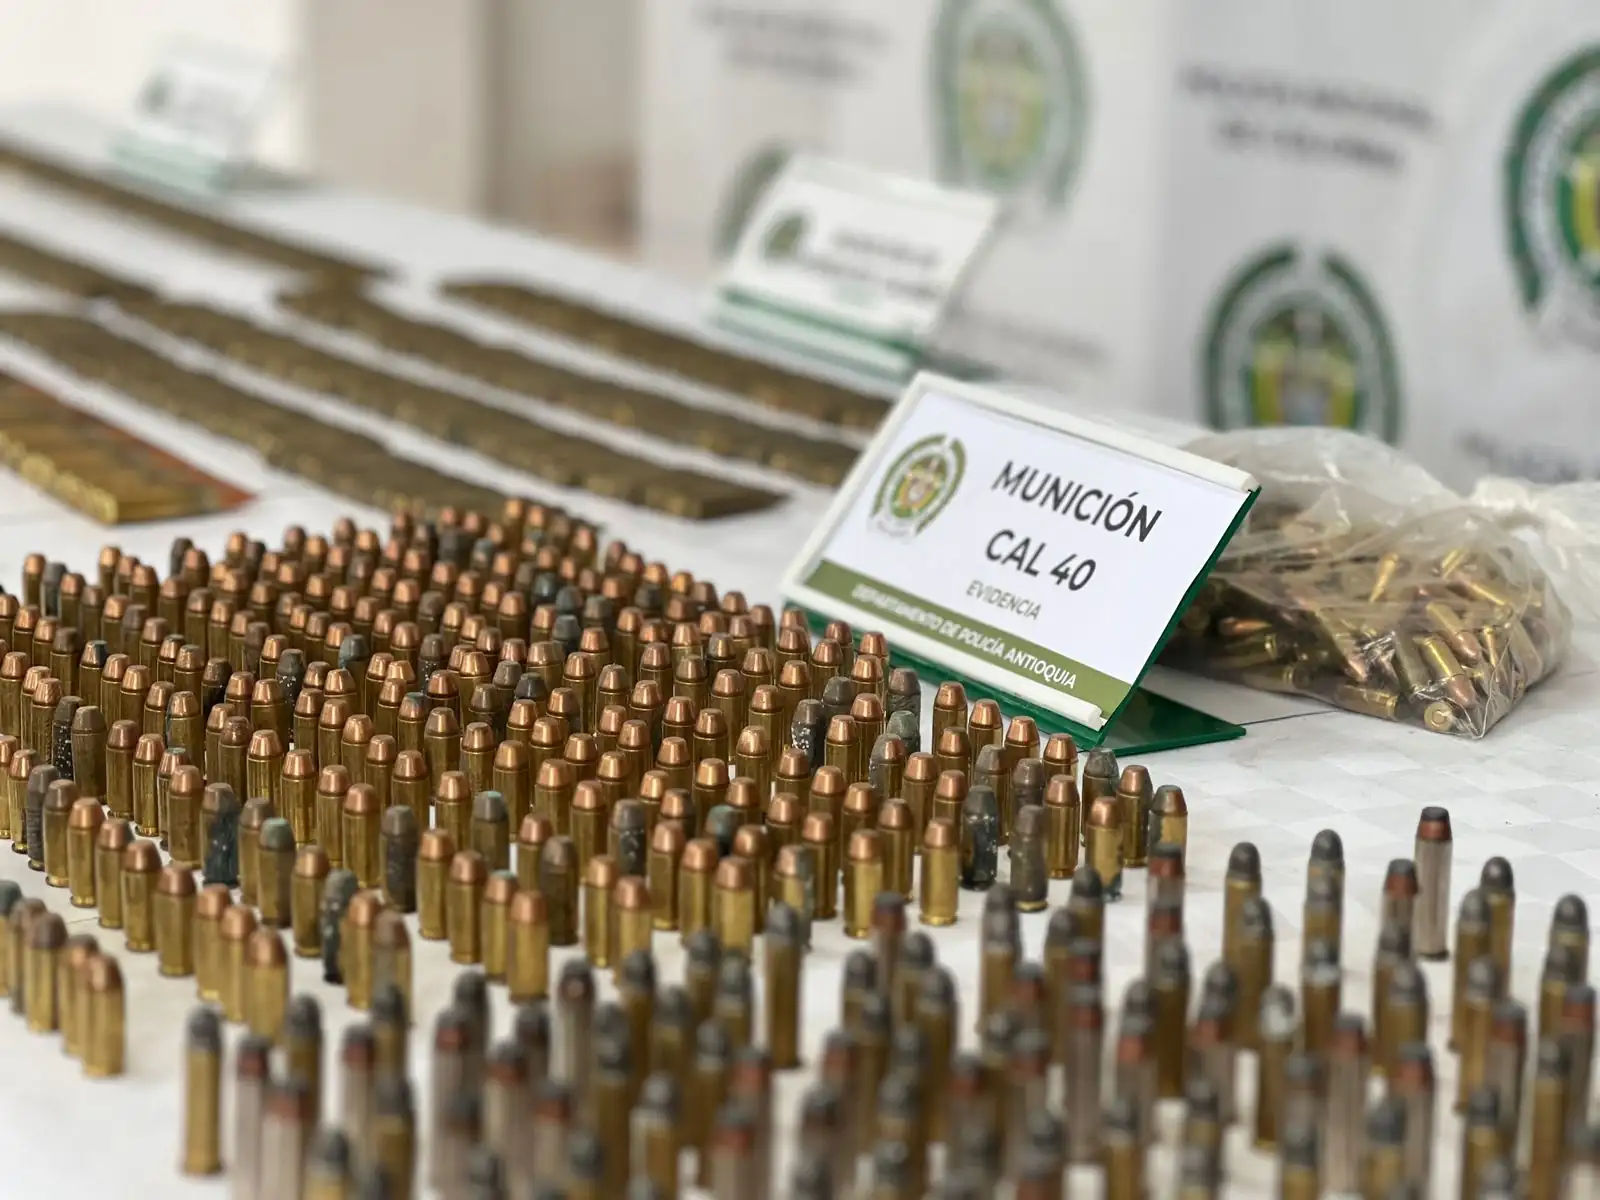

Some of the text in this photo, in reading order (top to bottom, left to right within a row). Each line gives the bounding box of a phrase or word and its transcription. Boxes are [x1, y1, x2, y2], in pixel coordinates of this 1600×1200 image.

[991, 461, 1162, 542] MUNICIÓN
[985, 529, 1097, 592] CAL 40
[966, 580, 1042, 620] EVIDENCIA
[938, 619, 961, 638] DE
[957, 624, 1006, 659] POLICÍA
[1004, 647, 1077, 690] ANTIOQUIA
